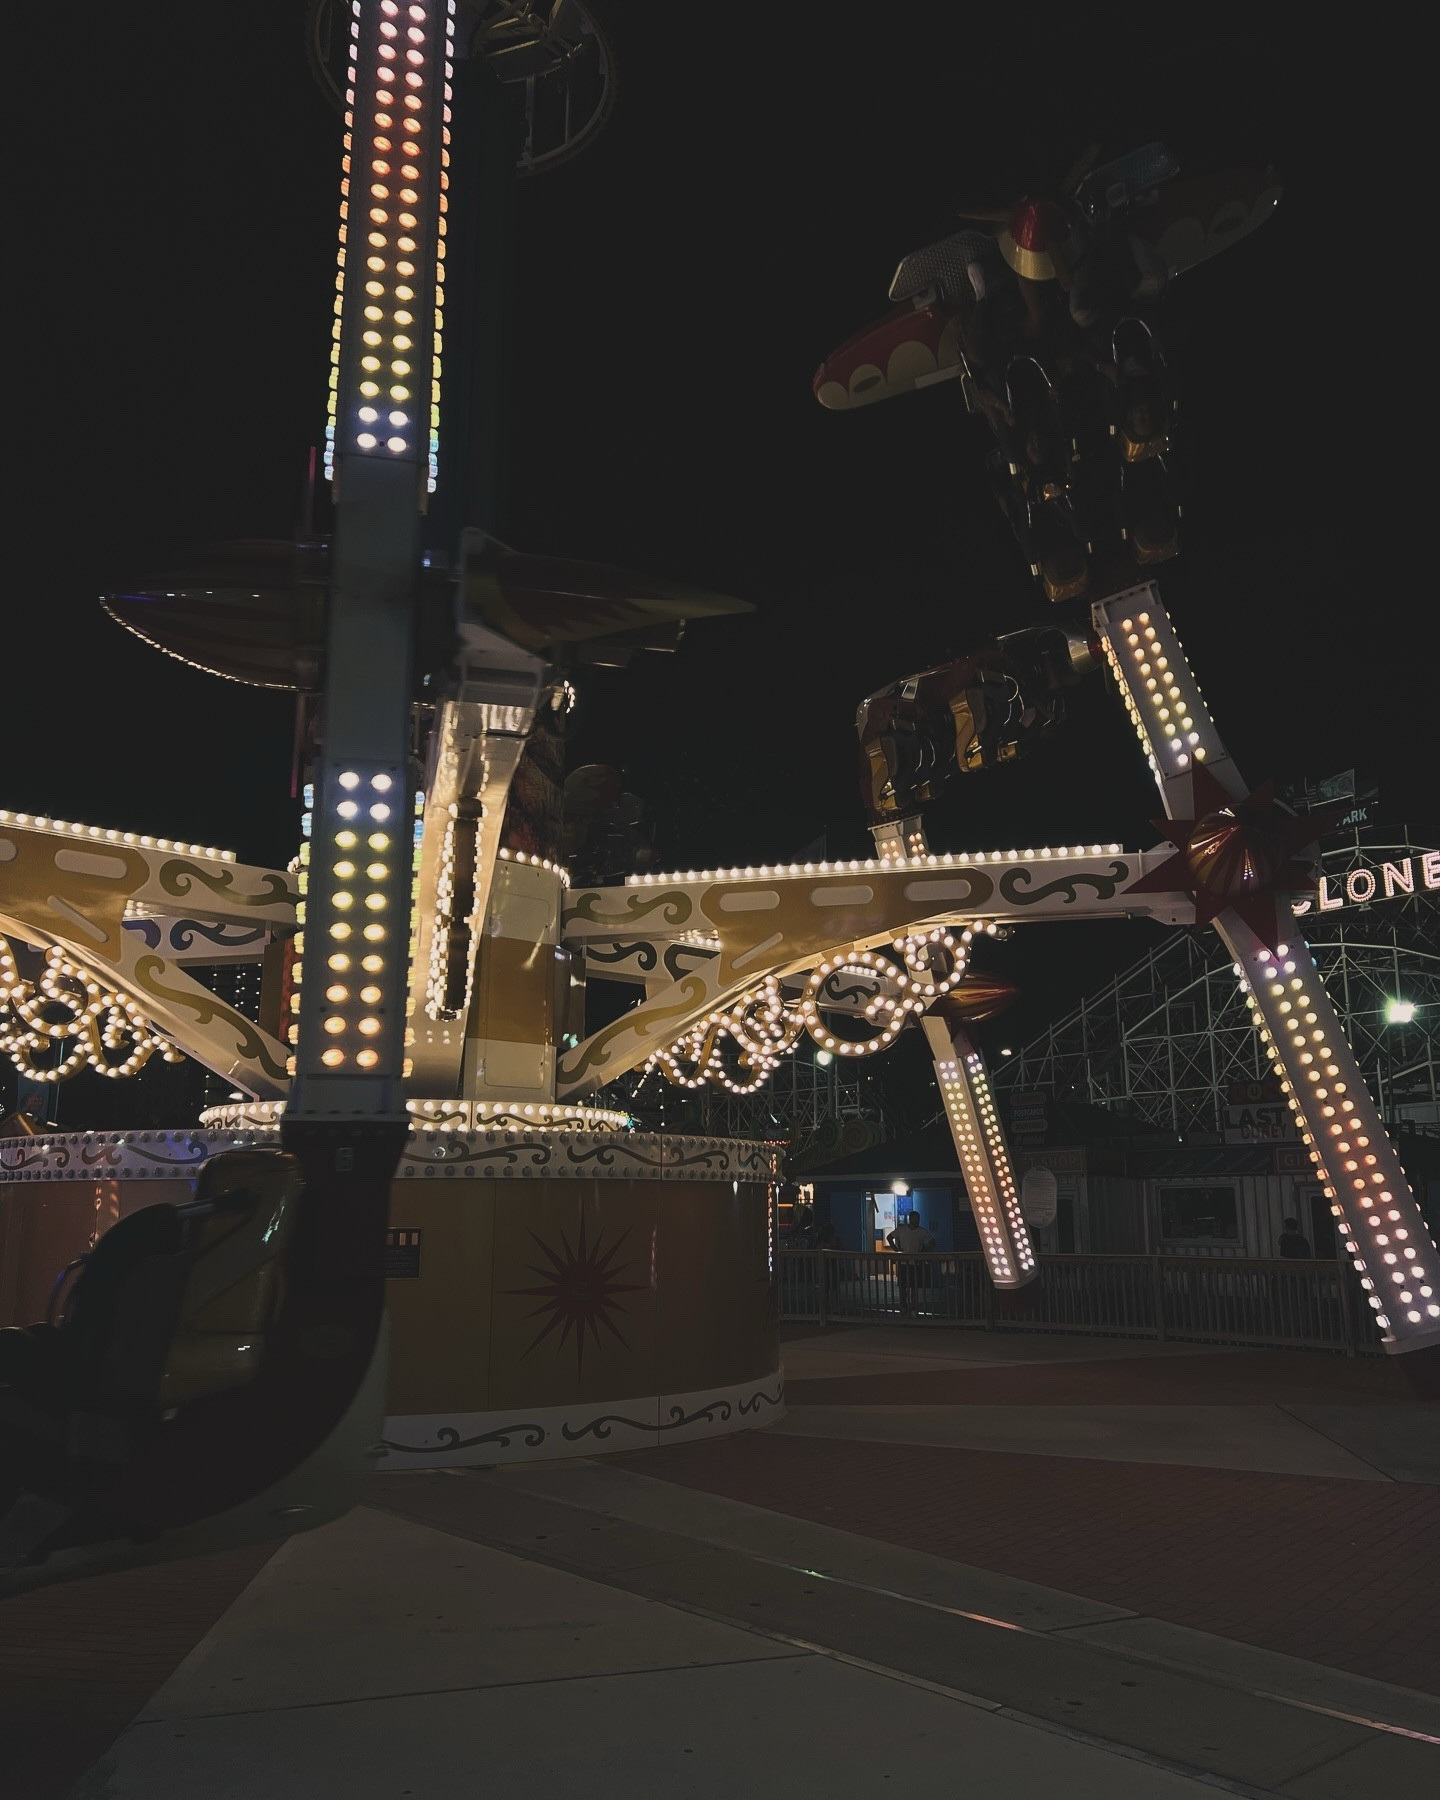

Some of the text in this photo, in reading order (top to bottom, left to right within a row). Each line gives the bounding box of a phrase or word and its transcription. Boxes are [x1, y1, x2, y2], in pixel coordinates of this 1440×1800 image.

[1336, 807, 1368, 827] ARK
[1291, 850, 1440, 914] LONE
[1224, 1106, 1286, 1129] LAST
